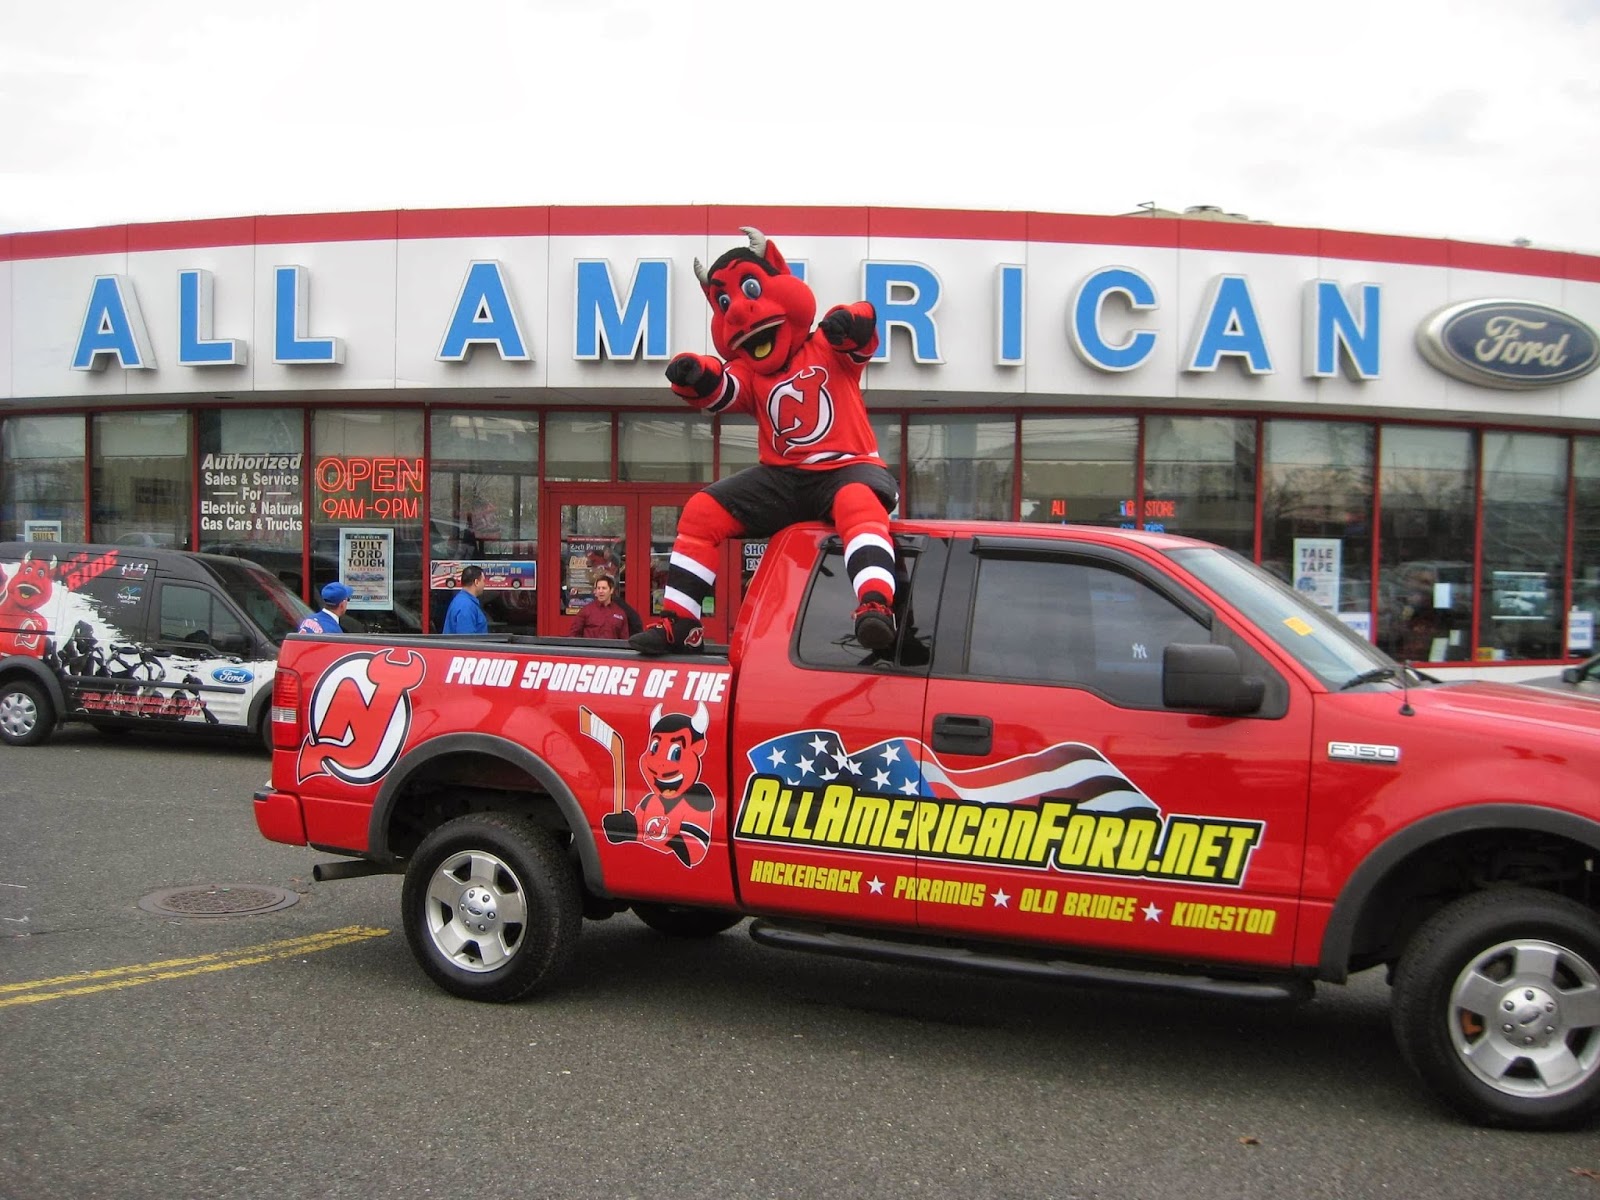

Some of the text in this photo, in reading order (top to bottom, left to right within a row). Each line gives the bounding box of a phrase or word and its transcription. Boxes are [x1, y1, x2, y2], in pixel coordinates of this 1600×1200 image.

[70, 257, 1382, 383] ALL AMRICAN
[1474, 315, 1571, 367] Ford
[201, 453, 302, 470] Authorized
[204, 472, 299, 486] Sales & Service
[316, 457, 424, 493] OPEN
[242, 487, 262, 500] For
[201, 501, 303, 515] Electric & Natural
[322, 498, 418, 519] 9AM-9PM
[1144, 500, 1175, 517] STORE
[201, 516, 303, 531] Gas Cars & Trucks
[32, 532, 56, 541] BUILT
[350, 541, 382, 549] BUILT
[744, 543, 768, 556] SHO
[350, 550, 382, 558] FORD
[1301, 548, 1333, 558] TALE
[347, 559, 385, 568] TOUGH
[1301, 562, 1333, 572] TAPE
[219, 669, 247, 683] Ford
[445, 656, 730, 702] PROUD SPONSORS OF THE
[749, 860, 1277, 935] HACKENSACK PARAMUS OLD BRIDGE KINGSTON
